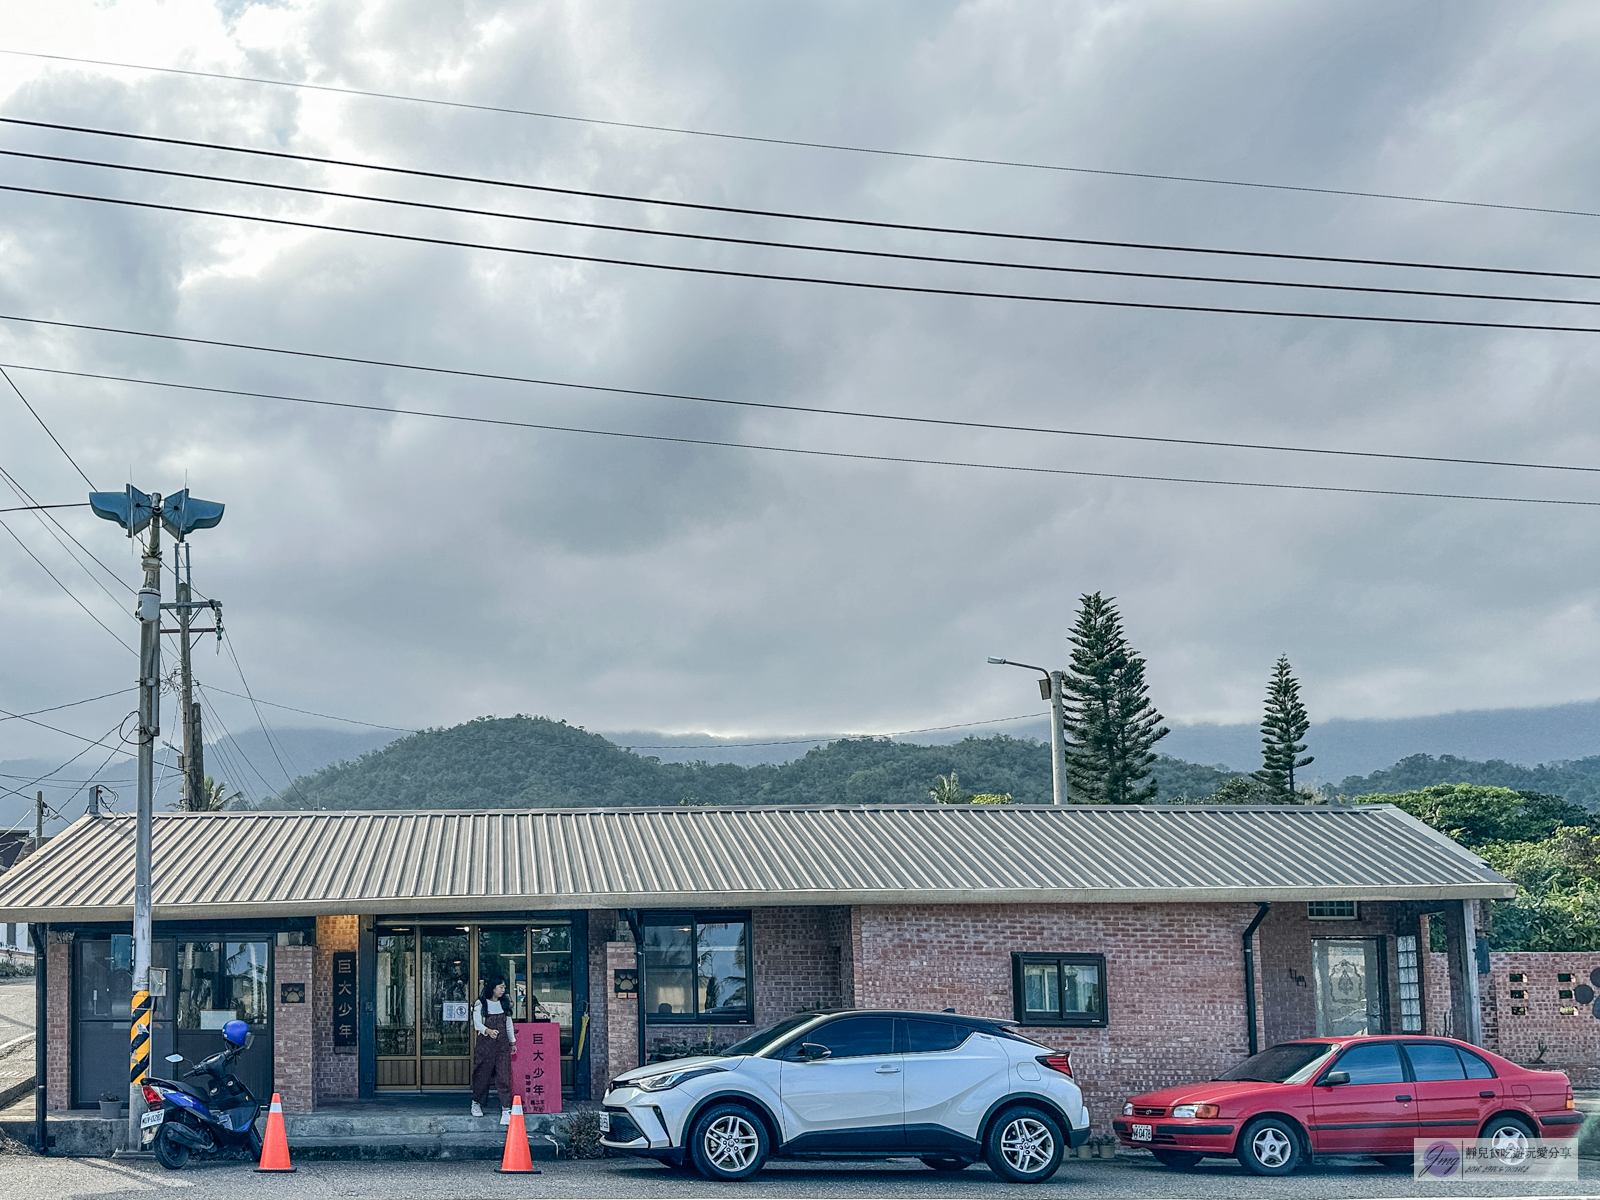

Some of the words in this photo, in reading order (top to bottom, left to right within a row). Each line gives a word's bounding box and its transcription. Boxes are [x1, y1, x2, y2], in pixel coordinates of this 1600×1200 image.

[338, 959, 352, 1039] 巨大少年
[533, 1033, 545, 1096] 巨大少年
